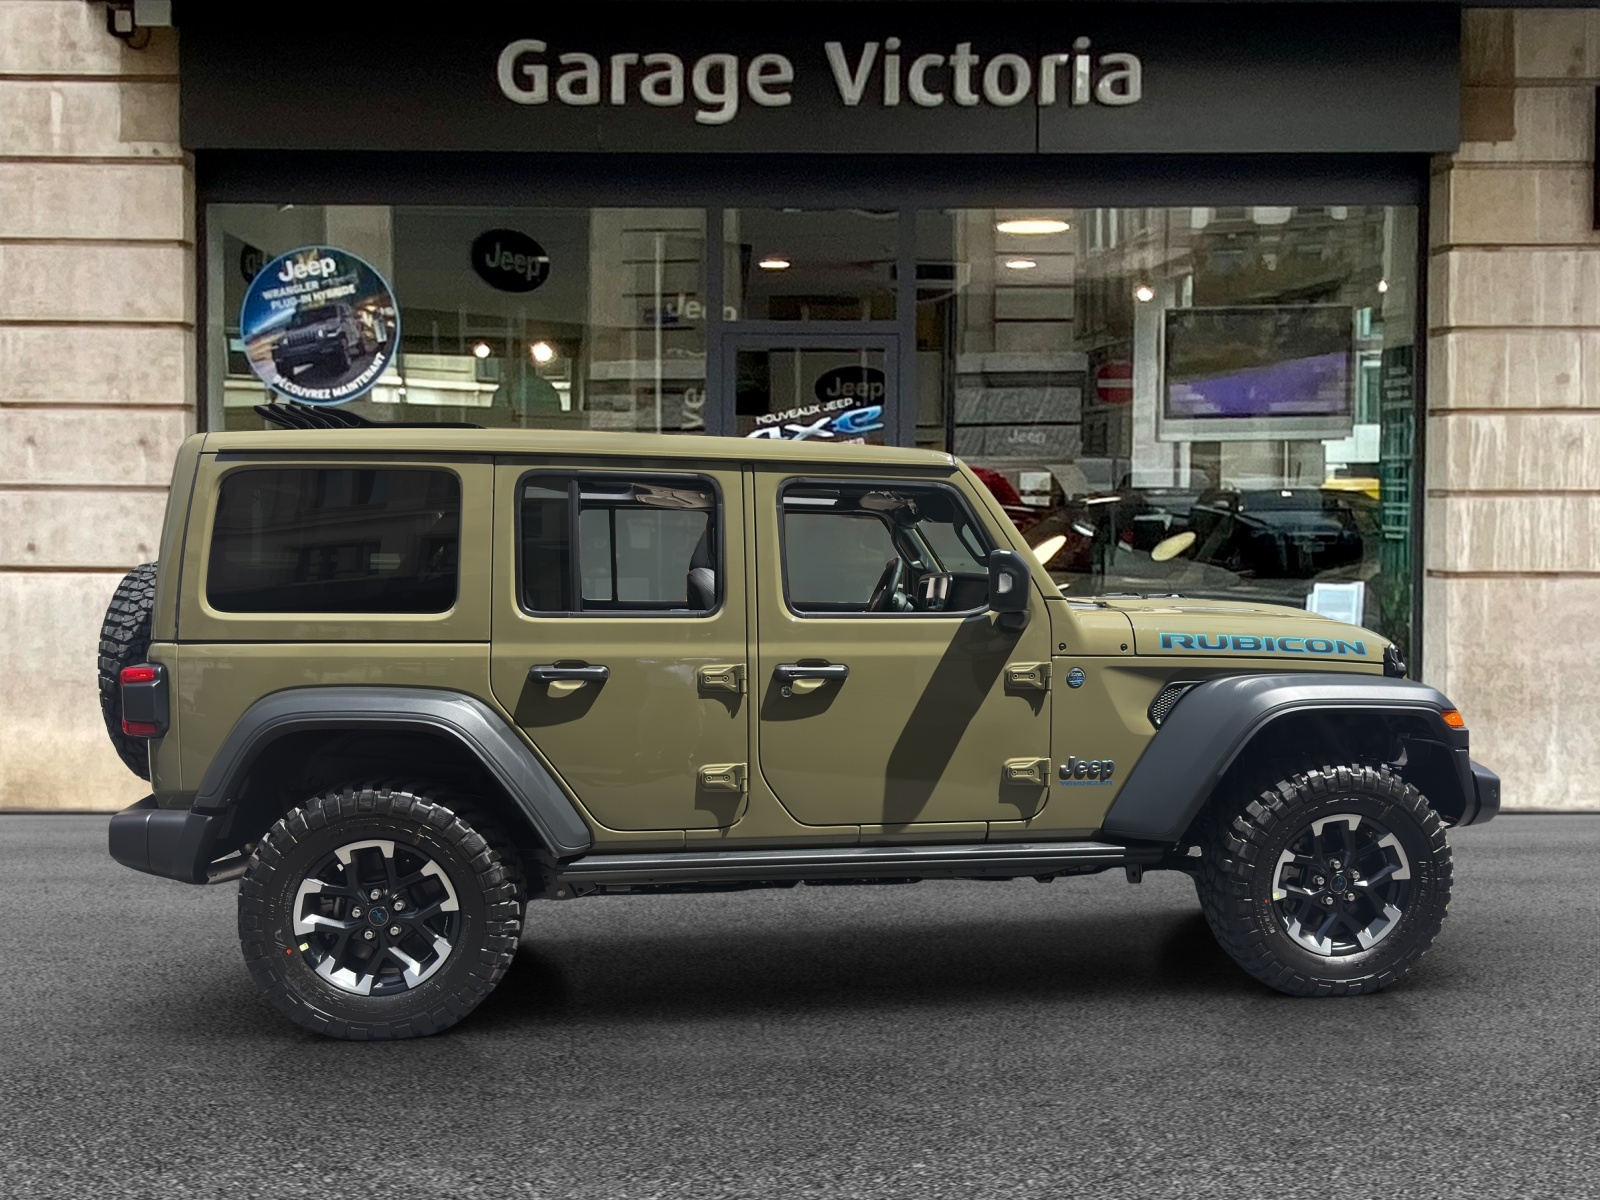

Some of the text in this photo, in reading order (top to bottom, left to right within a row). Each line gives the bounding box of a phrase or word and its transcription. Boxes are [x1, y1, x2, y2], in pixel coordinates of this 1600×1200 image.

[497, 35, 1143, 125] Garage Victoria
[278, 257, 337, 282] Jeep
[485, 241, 541, 281] Jeep
[262, 280, 320, 300] WRANGLER
[332, 351, 387, 397] MAINTENANT
[826, 377, 885, 401] Jeep
[755, 398, 854, 425] NOUVEAUX JEEP
[1159, 632, 1368, 657] RUBICON
[1059, 755, 1115, 781] Jeep
